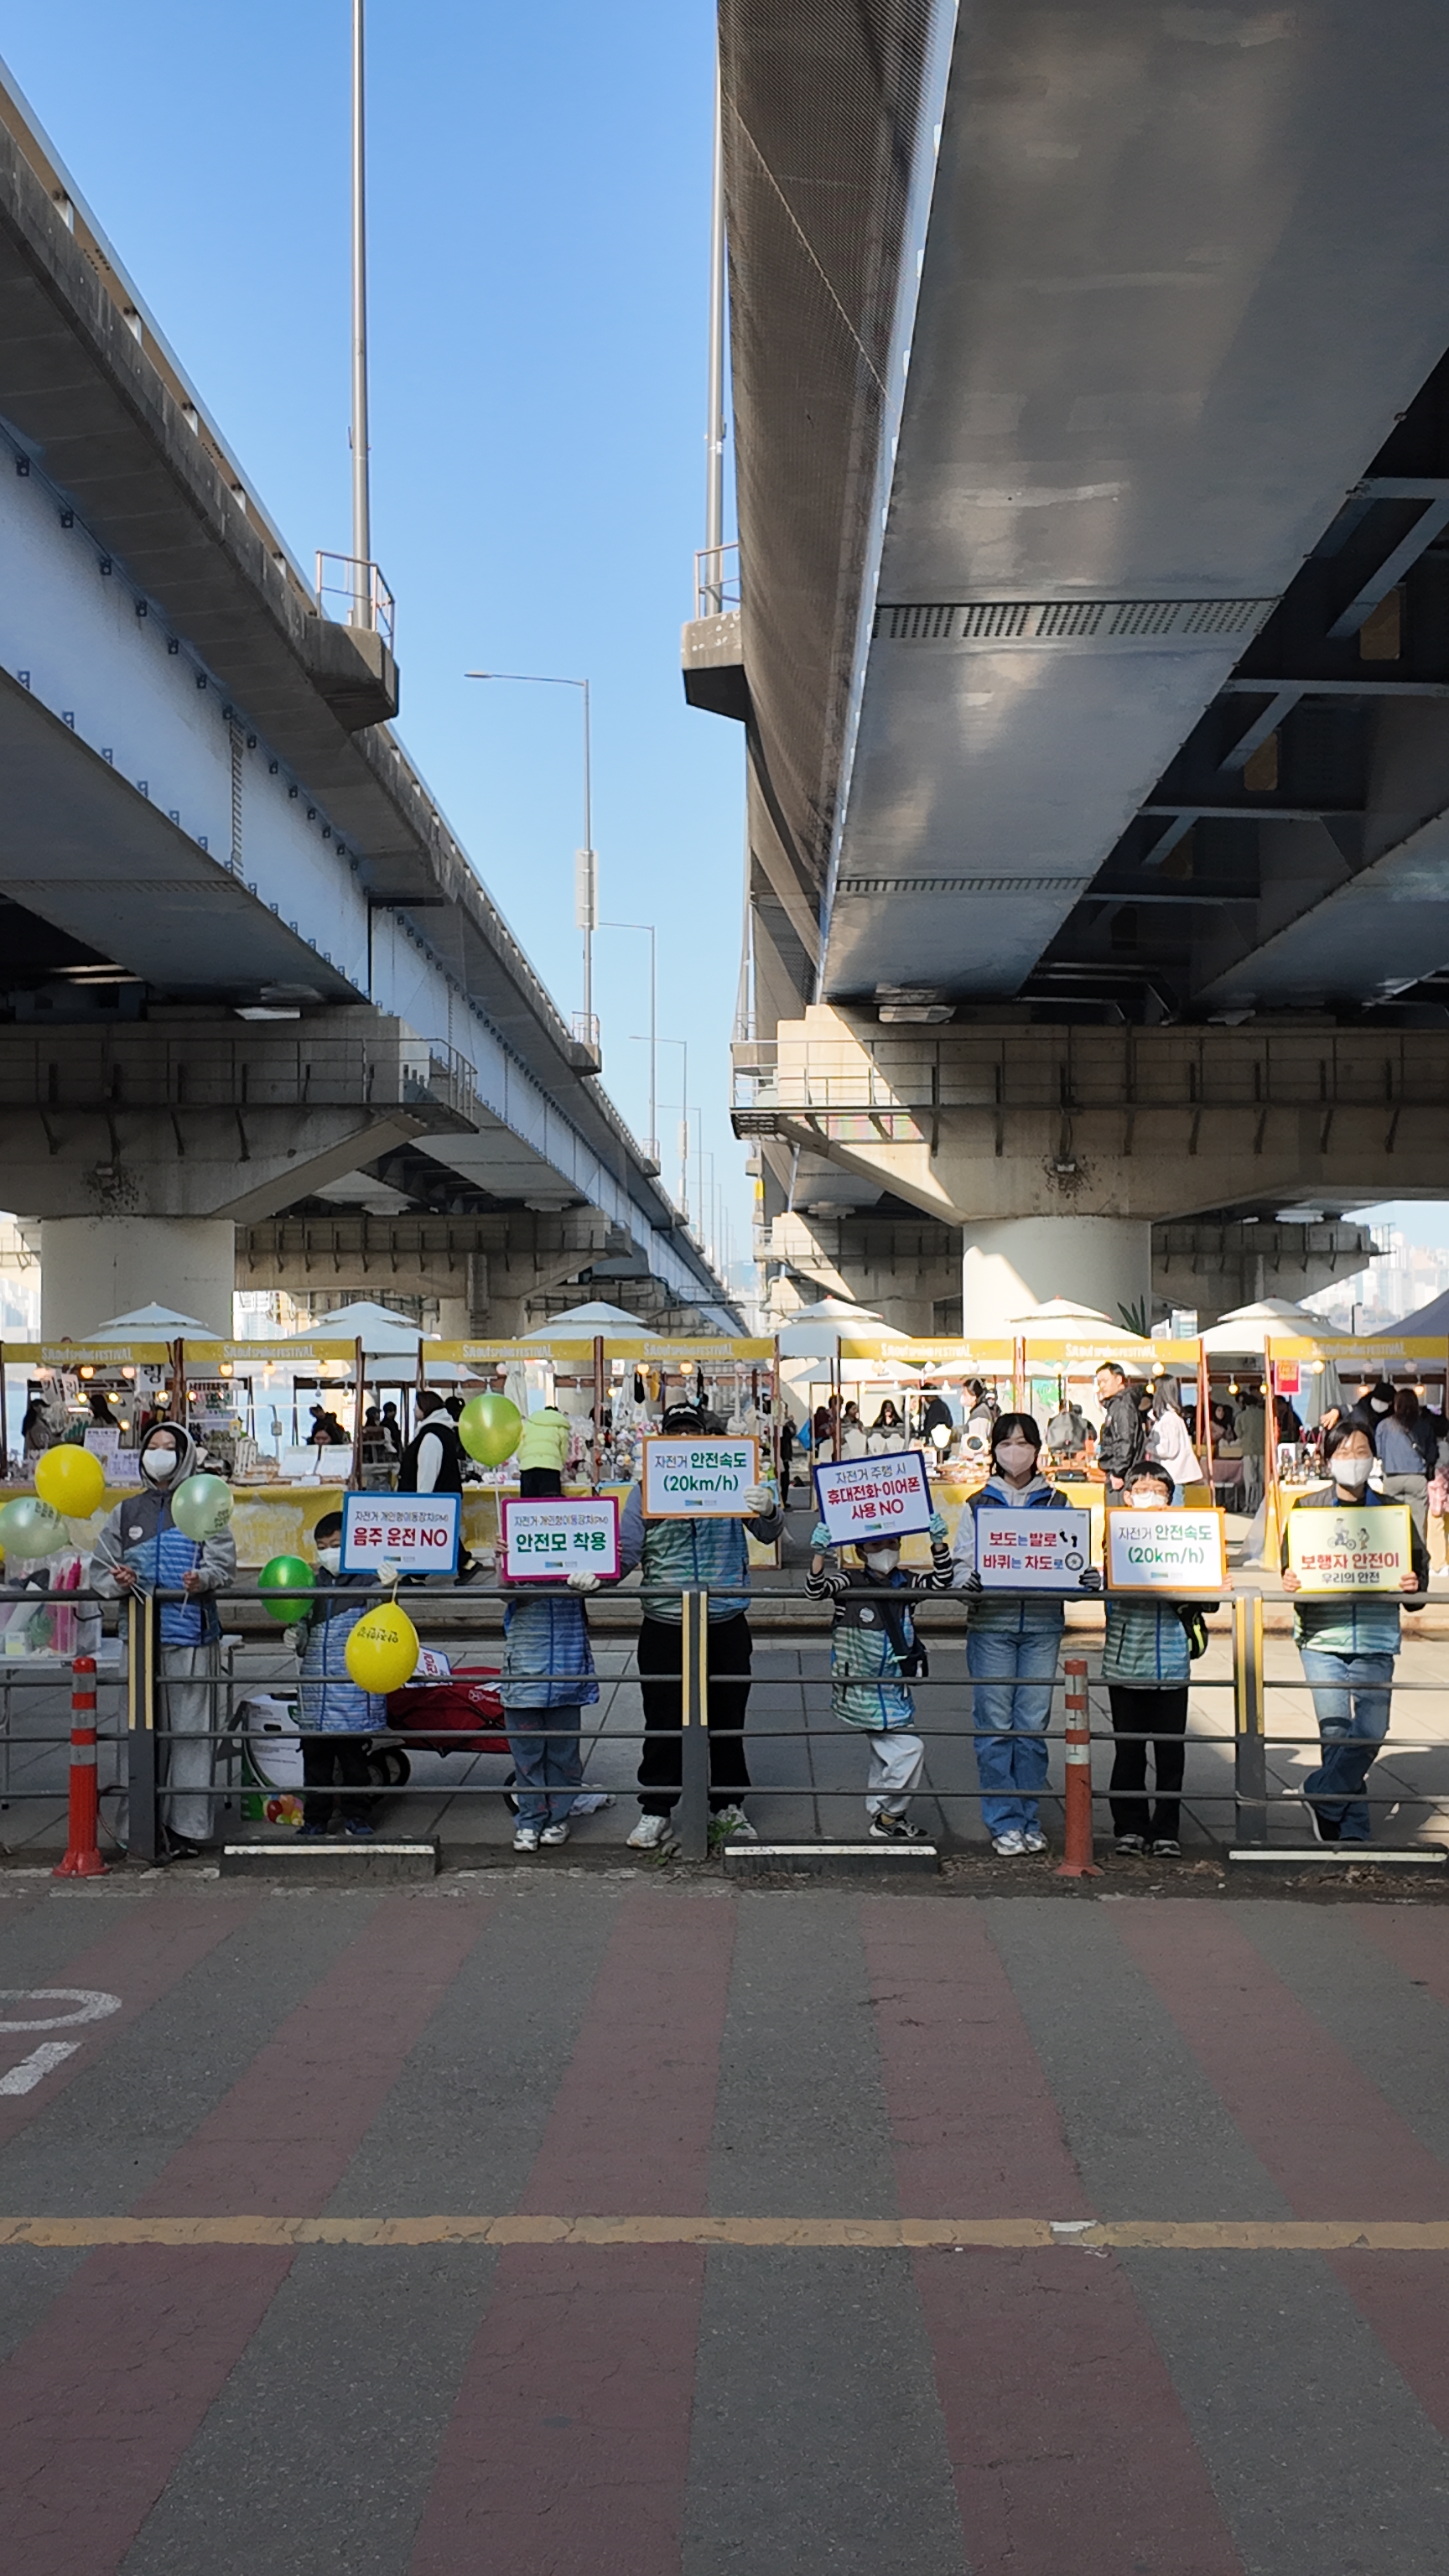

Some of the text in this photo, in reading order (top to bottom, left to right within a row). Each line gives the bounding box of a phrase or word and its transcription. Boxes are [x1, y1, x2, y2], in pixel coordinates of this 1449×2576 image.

[654, 1452, 747, 1469] 자전거 안전속도
[835, 1468, 869, 1484] 자전거
[896, 1462, 906, 1476] 시
[663, 1474, 739, 1492] (20km/h)
[851, 1498, 904, 1519] 사용 NO
[353, 1527, 448, 1547] 음주 운전 NO
[989, 1531, 1057, 1547] 보도는 발로
[1118, 1524, 1213, 1540] 자전거 안전속도
[517, 1531, 606, 1553] 안전모 착용
[983, 1554, 1064, 1570] 바퀴는 차도로
[1128, 1546, 1204, 1564] (20km/h)
[1301, 1552, 1400, 1570] 보행자 안전이
[1322, 1571, 1379, 1584] 우리의 안전
